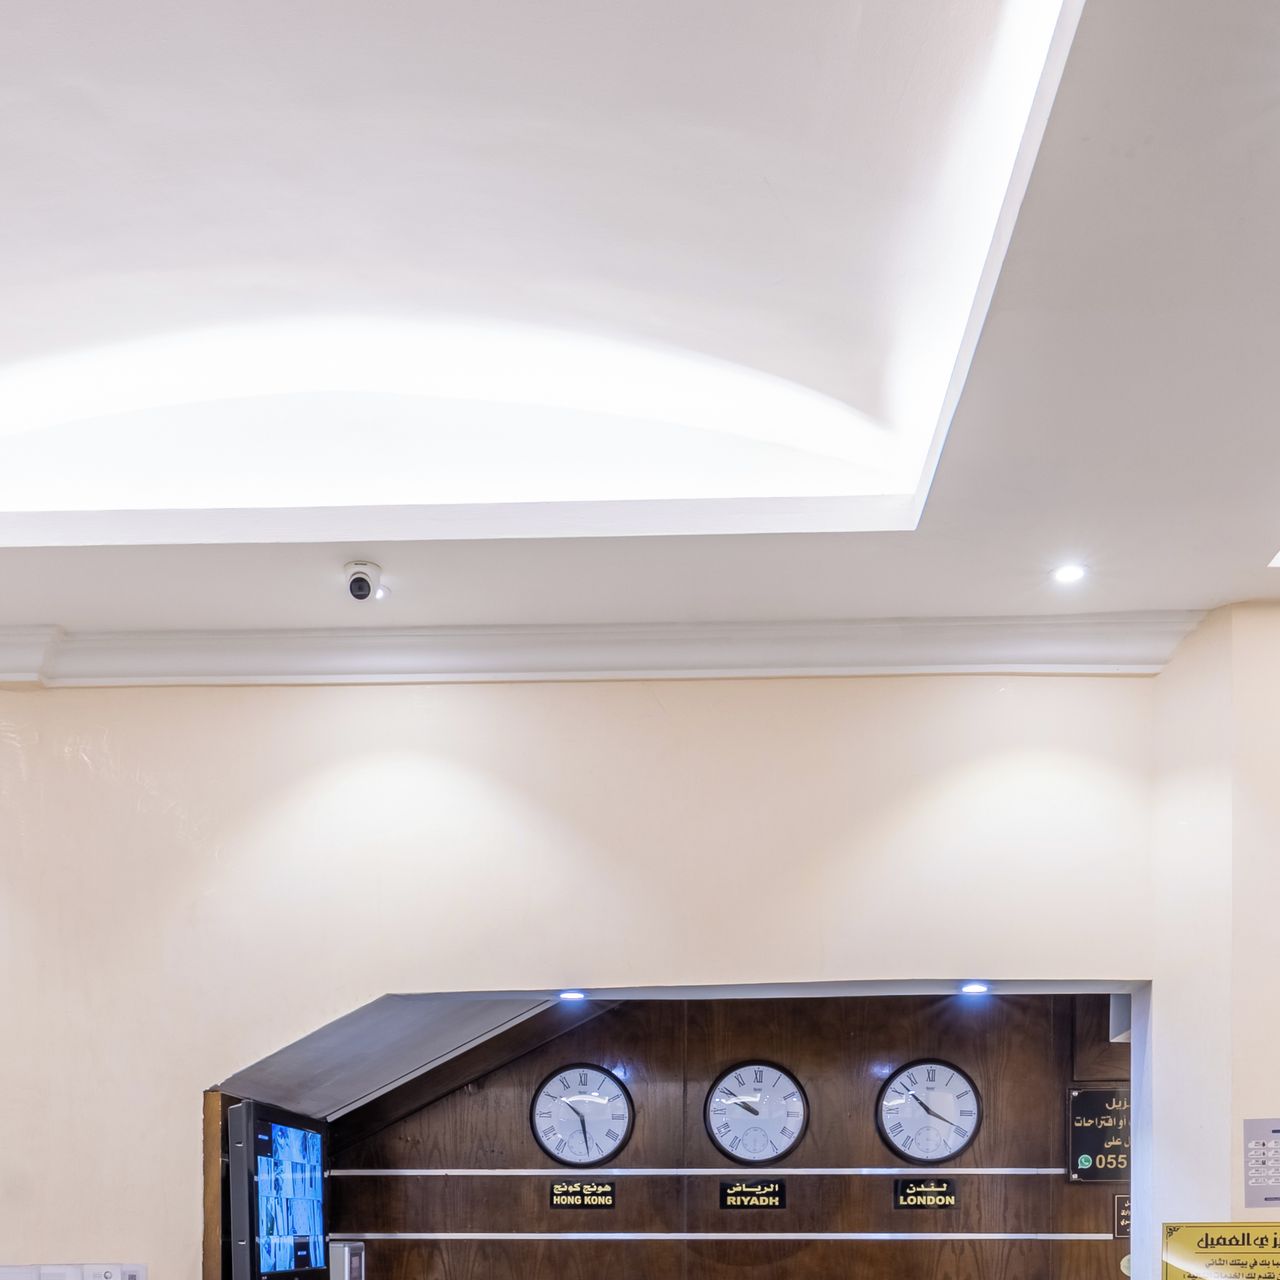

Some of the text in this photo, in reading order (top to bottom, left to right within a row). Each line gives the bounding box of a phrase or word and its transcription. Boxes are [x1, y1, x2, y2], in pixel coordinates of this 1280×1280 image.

[1106, 1098, 1131, 1110] زيل
[1074, 1116, 1116, 1129] اقتراحات
[1104, 1136, 1122, 1148] على
[1096, 1154, 1128, 1169] 055
[553, 1182, 612, 1194] هونج كونج
[727, 1183, 779, 1194] الرياض
[906, 1182, 947, 1194] لندن
[553, 1196, 613, 1205] HONG KONG
[727, 1196, 779, 1206] RIYADH
[900, 1196, 955, 1205] LONDON
[1197, 1232, 1251, 1249] العميل
[1229, 1259, 1248, 1268] بيتك
[1249, 1258, 1258, 1269] في
[1259, 1260, 1271, 1268] بك
[1257, 1272, 1276, 1280] نقدم
